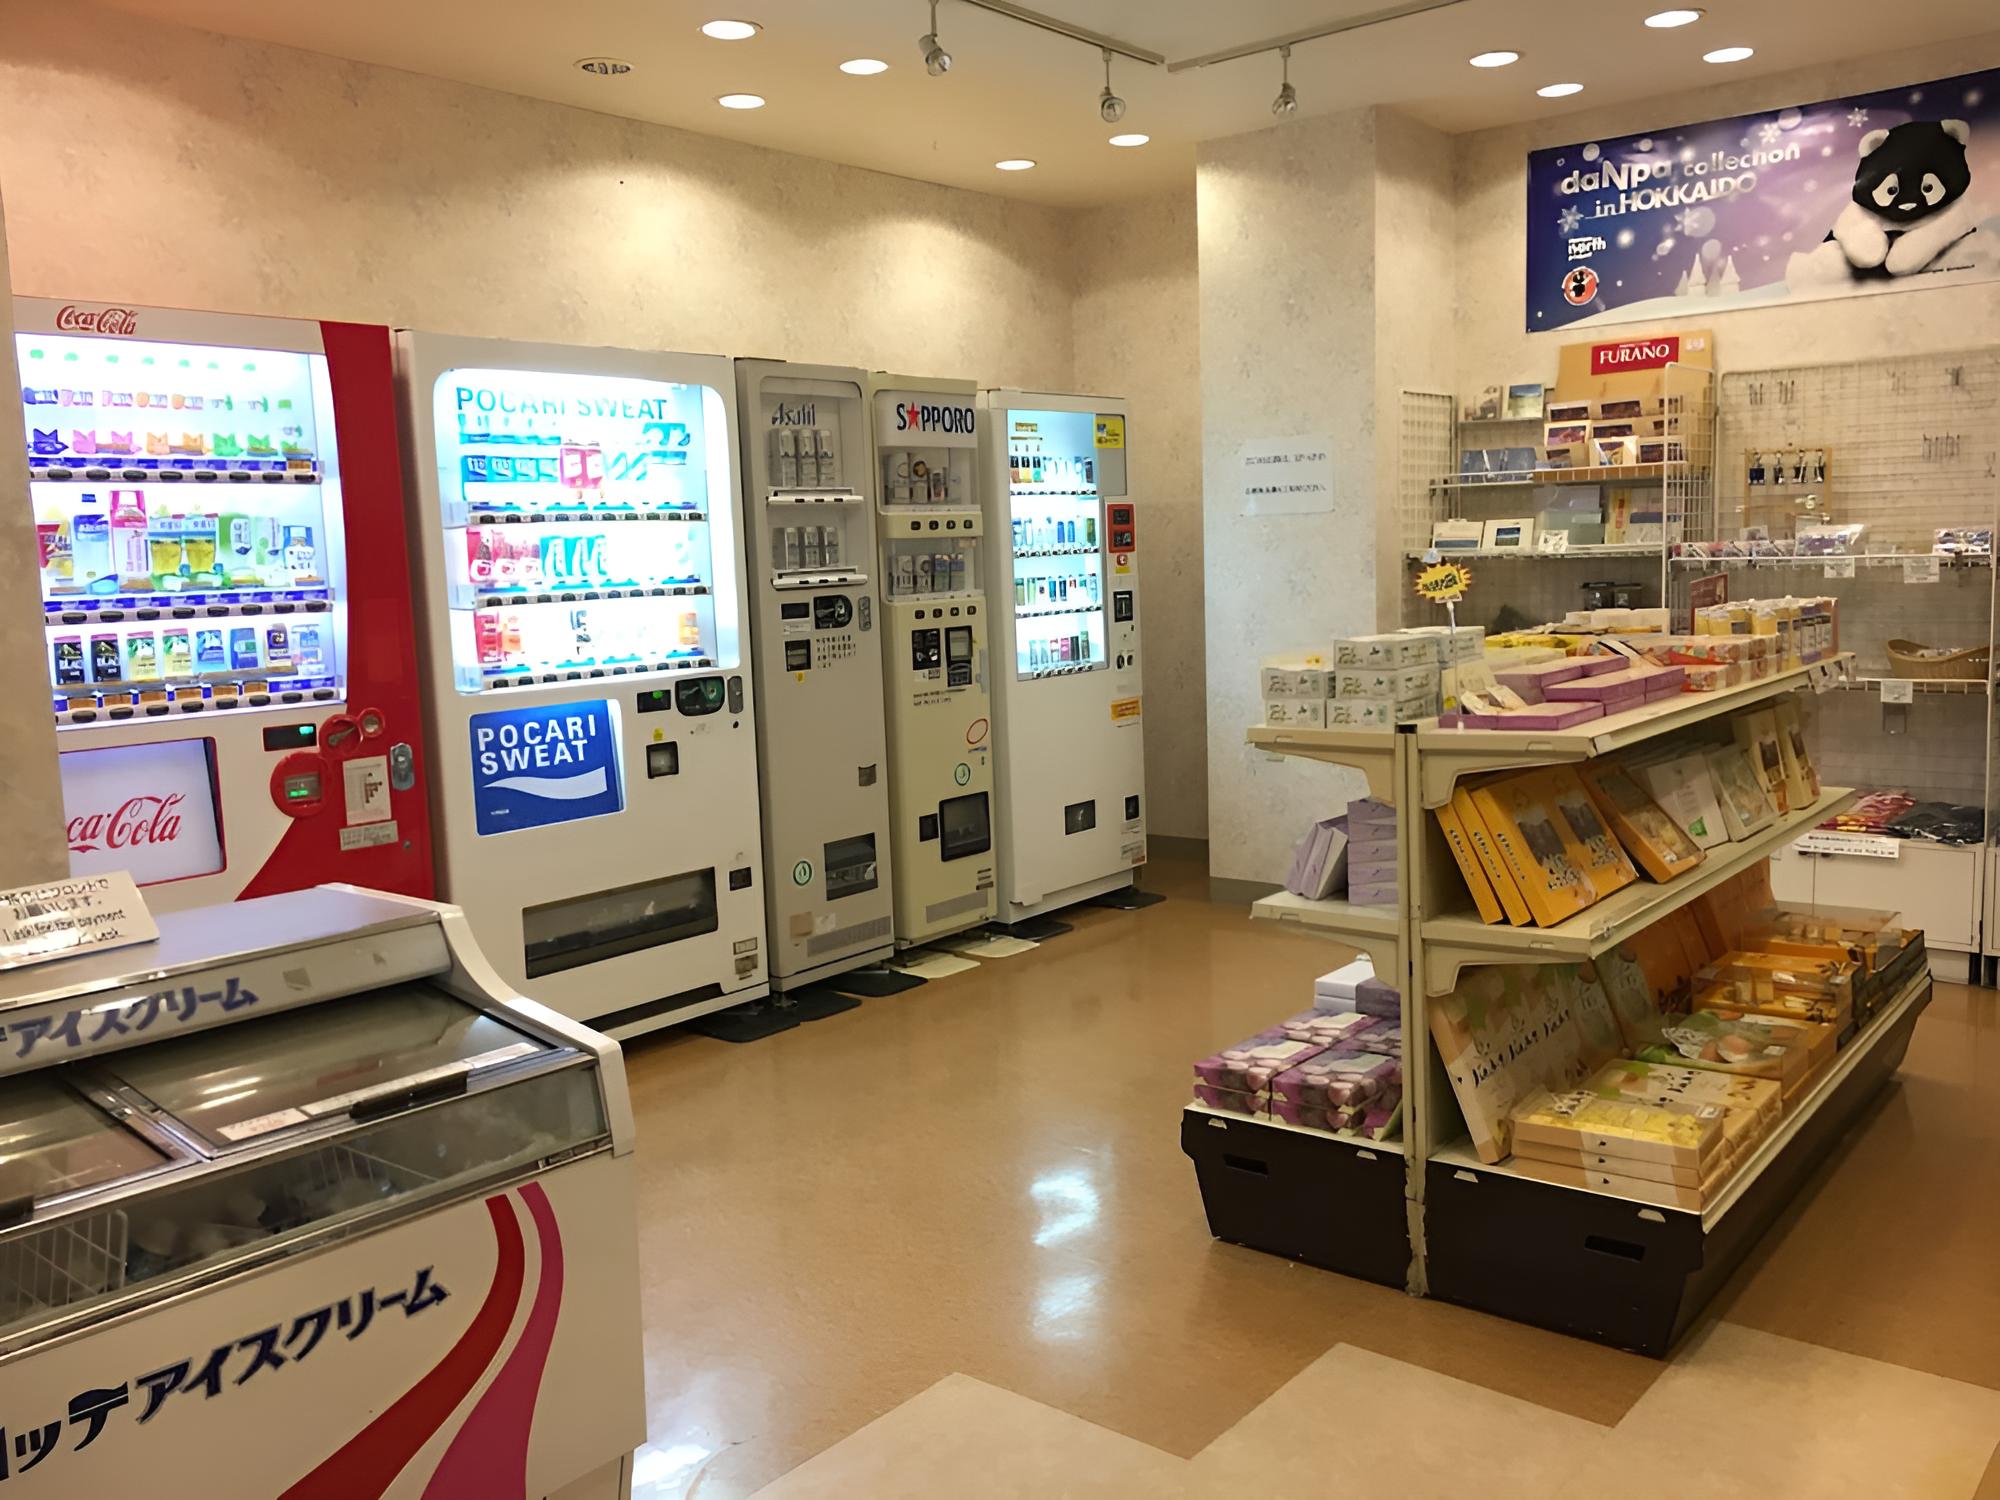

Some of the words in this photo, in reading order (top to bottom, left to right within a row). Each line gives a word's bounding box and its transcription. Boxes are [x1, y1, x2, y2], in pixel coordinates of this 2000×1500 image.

[1619, 171, 1757, 215] HOKKAIDO
[1600, 344, 1670, 365] FURANO
[578, 398, 667, 420] SWEAT
[771, 402, 816, 427] Asahi
[477, 714, 597, 752] POCARI
[480, 739, 588, 776] SWEAT
[0, 977, 259, 1058] アイスクリーム
